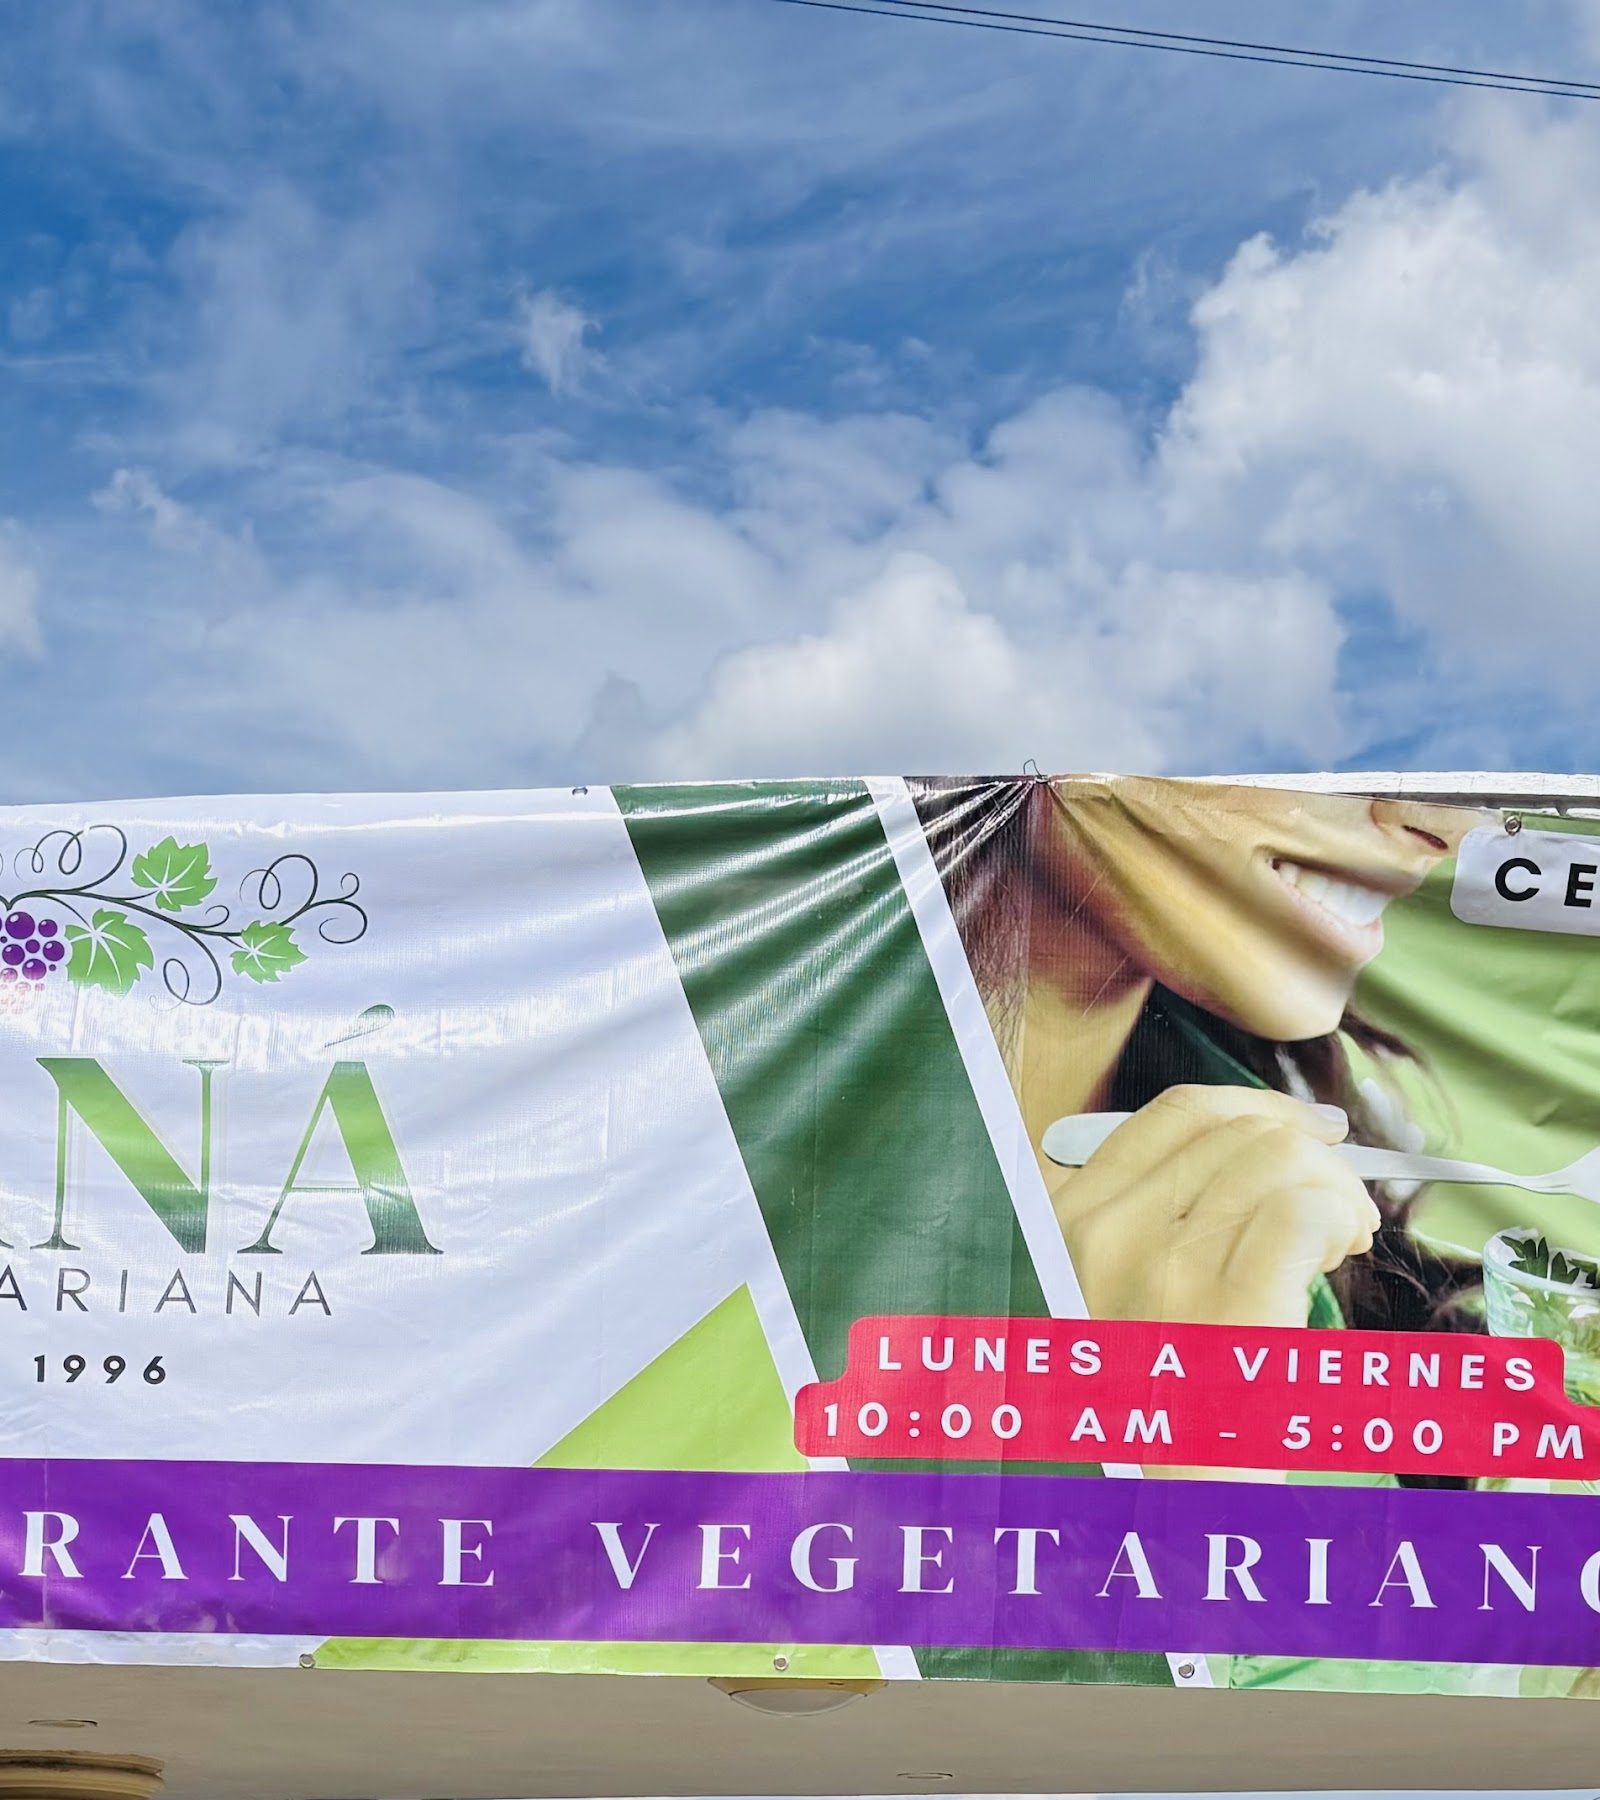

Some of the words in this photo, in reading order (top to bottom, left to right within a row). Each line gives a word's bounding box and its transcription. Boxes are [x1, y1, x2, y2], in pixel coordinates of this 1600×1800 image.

[32, 1353, 169, 1386] 1996
[877, 1336, 1102, 1377] LUNES
[1150, 1341, 1187, 1379] A
[1232, 1346, 1536, 1393] VIERNES
[823, 1402, 1023, 1440] 10:00
[1070, 1408, 1173, 1445] AM
[1283, 1414, 1443, 1457] 5:00
[1492, 1422, 1585, 1461] PM
